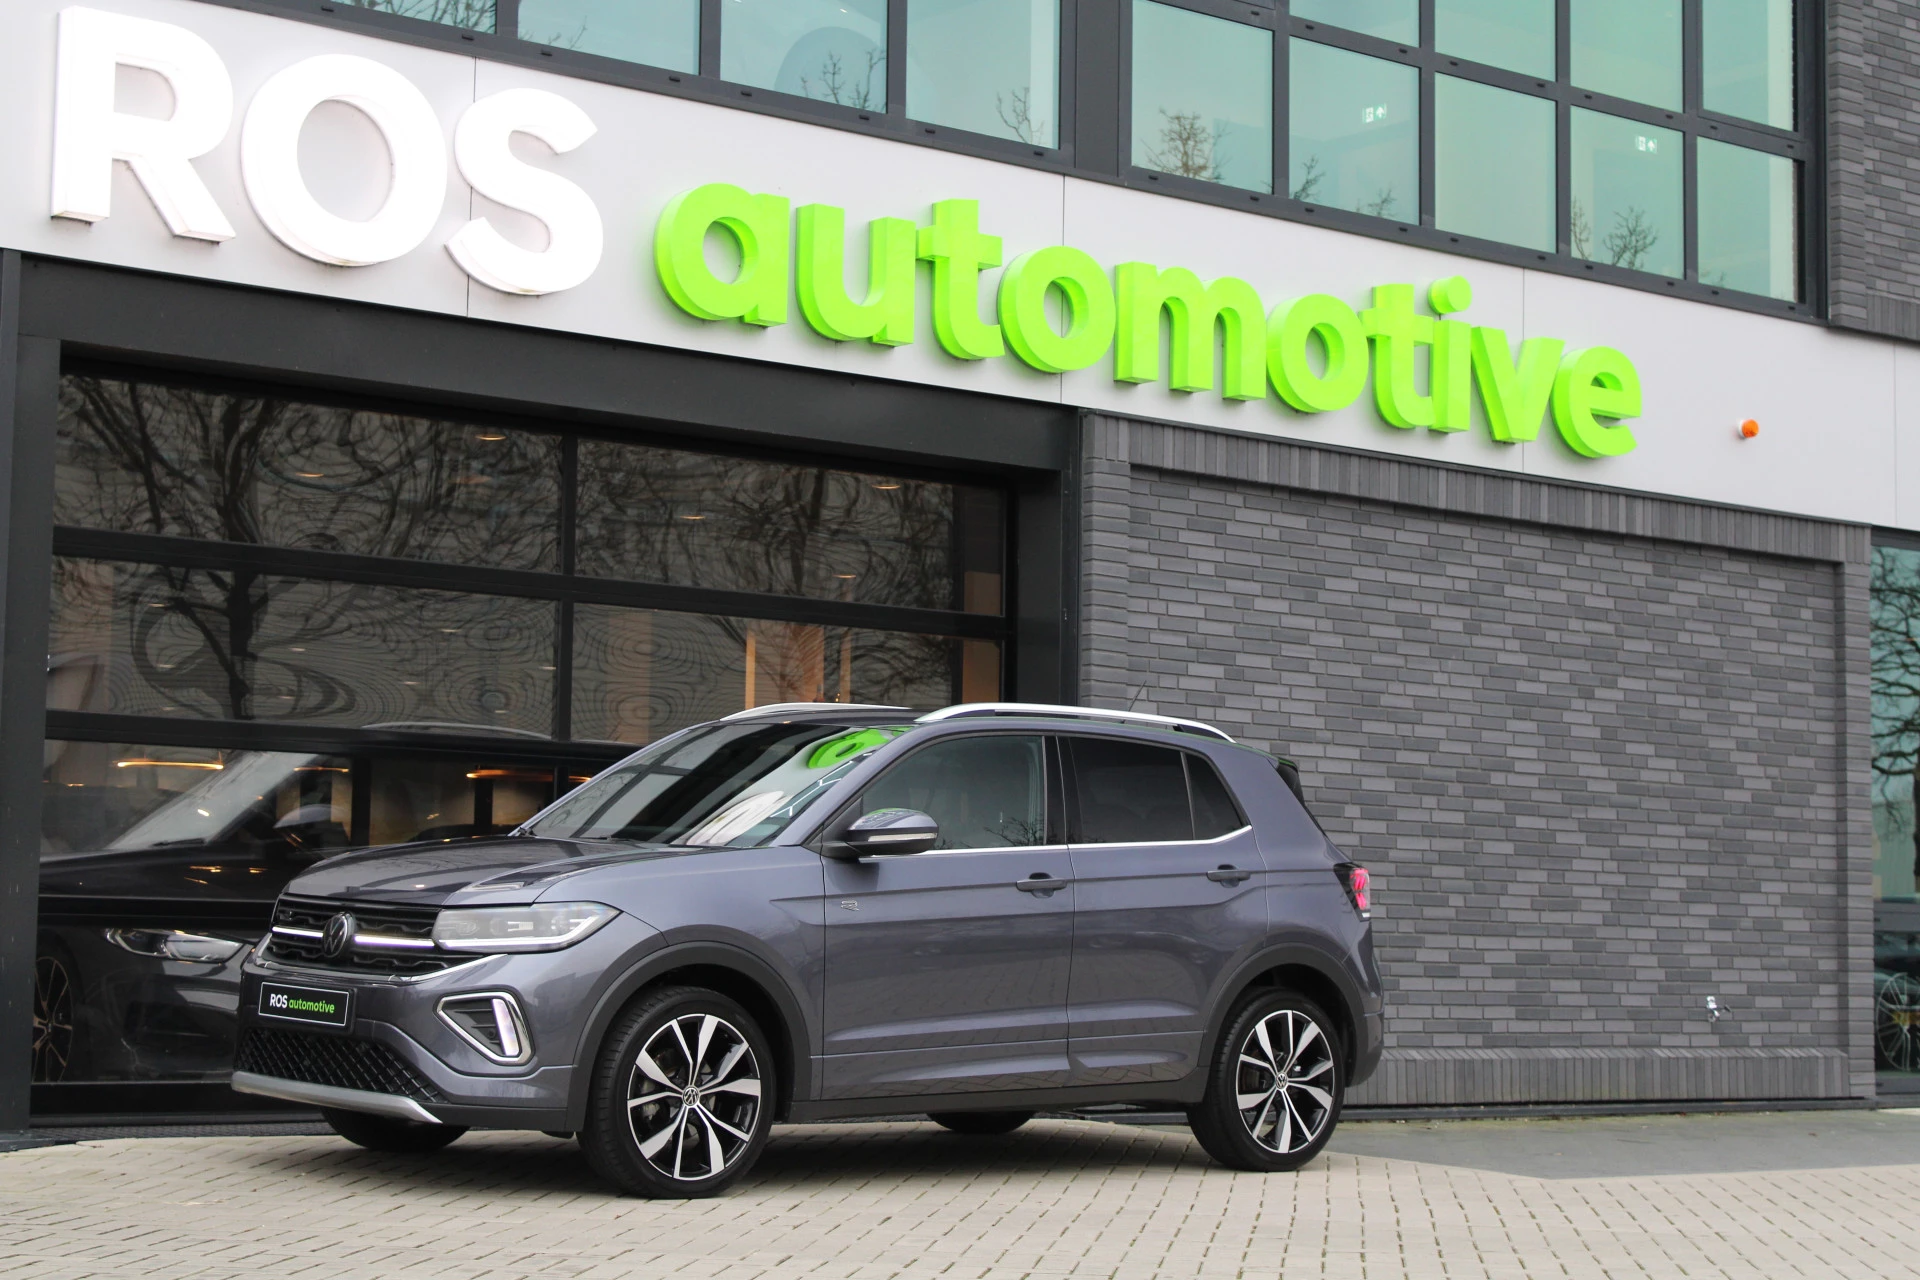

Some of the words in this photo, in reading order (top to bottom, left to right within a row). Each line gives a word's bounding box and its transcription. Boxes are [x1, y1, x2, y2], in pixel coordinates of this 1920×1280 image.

[51, 7, 604, 297] ROS
[653, 183, 1642, 459] automotive
[269, 993, 288, 1010] ROS
[288, 998, 336, 1014] automotive
